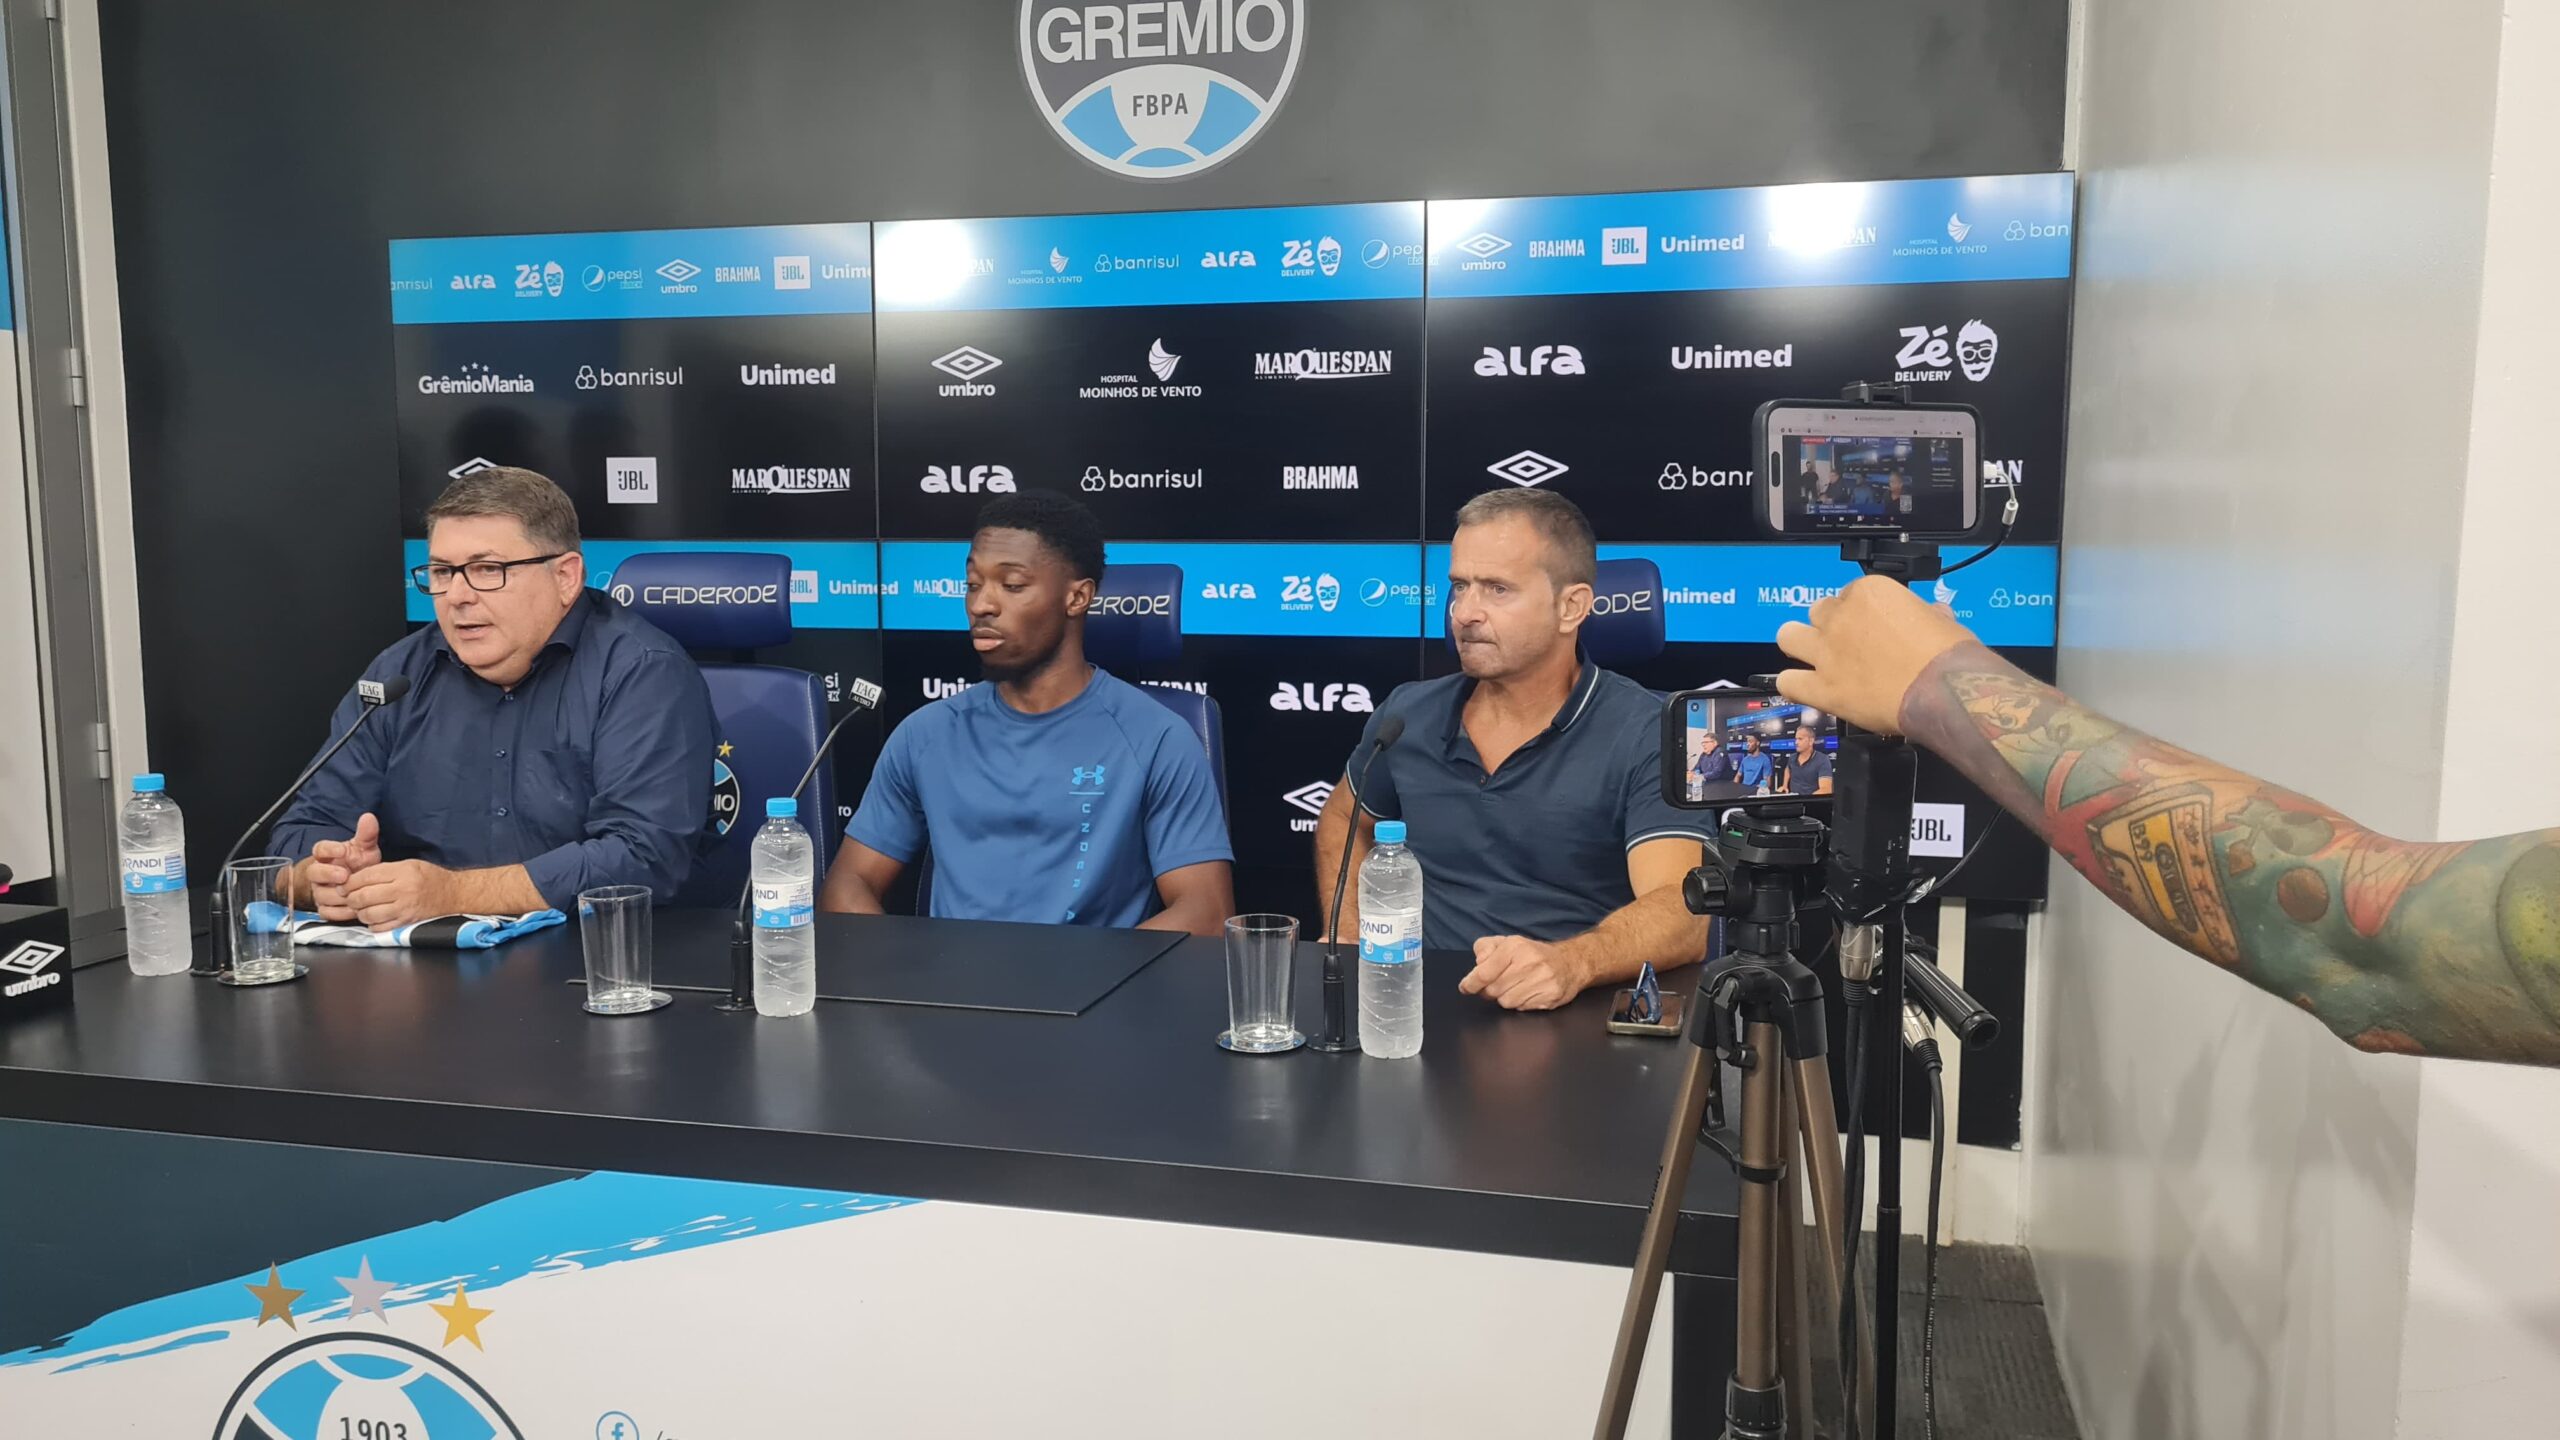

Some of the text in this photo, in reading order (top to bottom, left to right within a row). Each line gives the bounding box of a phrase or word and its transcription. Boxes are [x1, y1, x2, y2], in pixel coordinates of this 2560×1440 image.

[1132, 93, 1188, 117] FBPA
[1529, 239, 1586, 258] BRAHMA
[1612, 238, 1639, 254] JBL
[1661, 234, 1745, 253] Unimed
[1892, 245, 1988, 256] MOINHOS DE VENTO
[1114, 254, 1179, 270] banrisul
[1201, 251, 1257, 268] alfa
[1281, 240, 1316, 268] Zé
[607, 268, 642, 282] pepsi
[715, 266, 761, 283] BRAHMA
[782, 265, 805, 281] JBL
[1281, 269, 1316, 277] DELIVERY
[1462, 259, 1506, 271] umbro
[451, 274, 496, 290] alfa
[514, 264, 544, 289] Zé
[660, 284, 698, 294] umbro
[1671, 344, 1792, 370] Unimed
[1895, 326, 1953, 368] Zé
[1254, 348, 1393, 380] MARQUESPAN
[1474, 345, 1586, 376] alfa
[418, 374, 535, 394] GrêmioMania
[600, 366, 683, 387] banrisul
[740, 363, 836, 386] Unimed
[1100, 375, 1138, 383] HOSPITAL
[1895, 370, 1953, 383] DELIVERY
[938, 382, 995, 397] umbro
[1079, 385, 1202, 398] MOINHOS DE VENTO
[617, 470, 649, 491] JBL
[731, 465, 851, 494] MARQUESPAN
[920, 465, 1017, 493] alfa
[1109, 467, 1202, 489] banrisul
[1283, 466, 1359, 490] BRAHMA
[829, 580, 899, 596] Unimed
[1201, 583, 1257, 599] alfa
[1281, 575, 1314, 602] Zé
[1590, 590, 1651, 615] ODE
[360, 683, 380, 697] TAG
[855, 680, 878, 700] TAG
[1270, 682, 1374, 713] alfa
[1911, 818, 1952, 842] JBL
[5, 971, 61, 997] umbro
[340, 1417, 407, 1440] 1903
